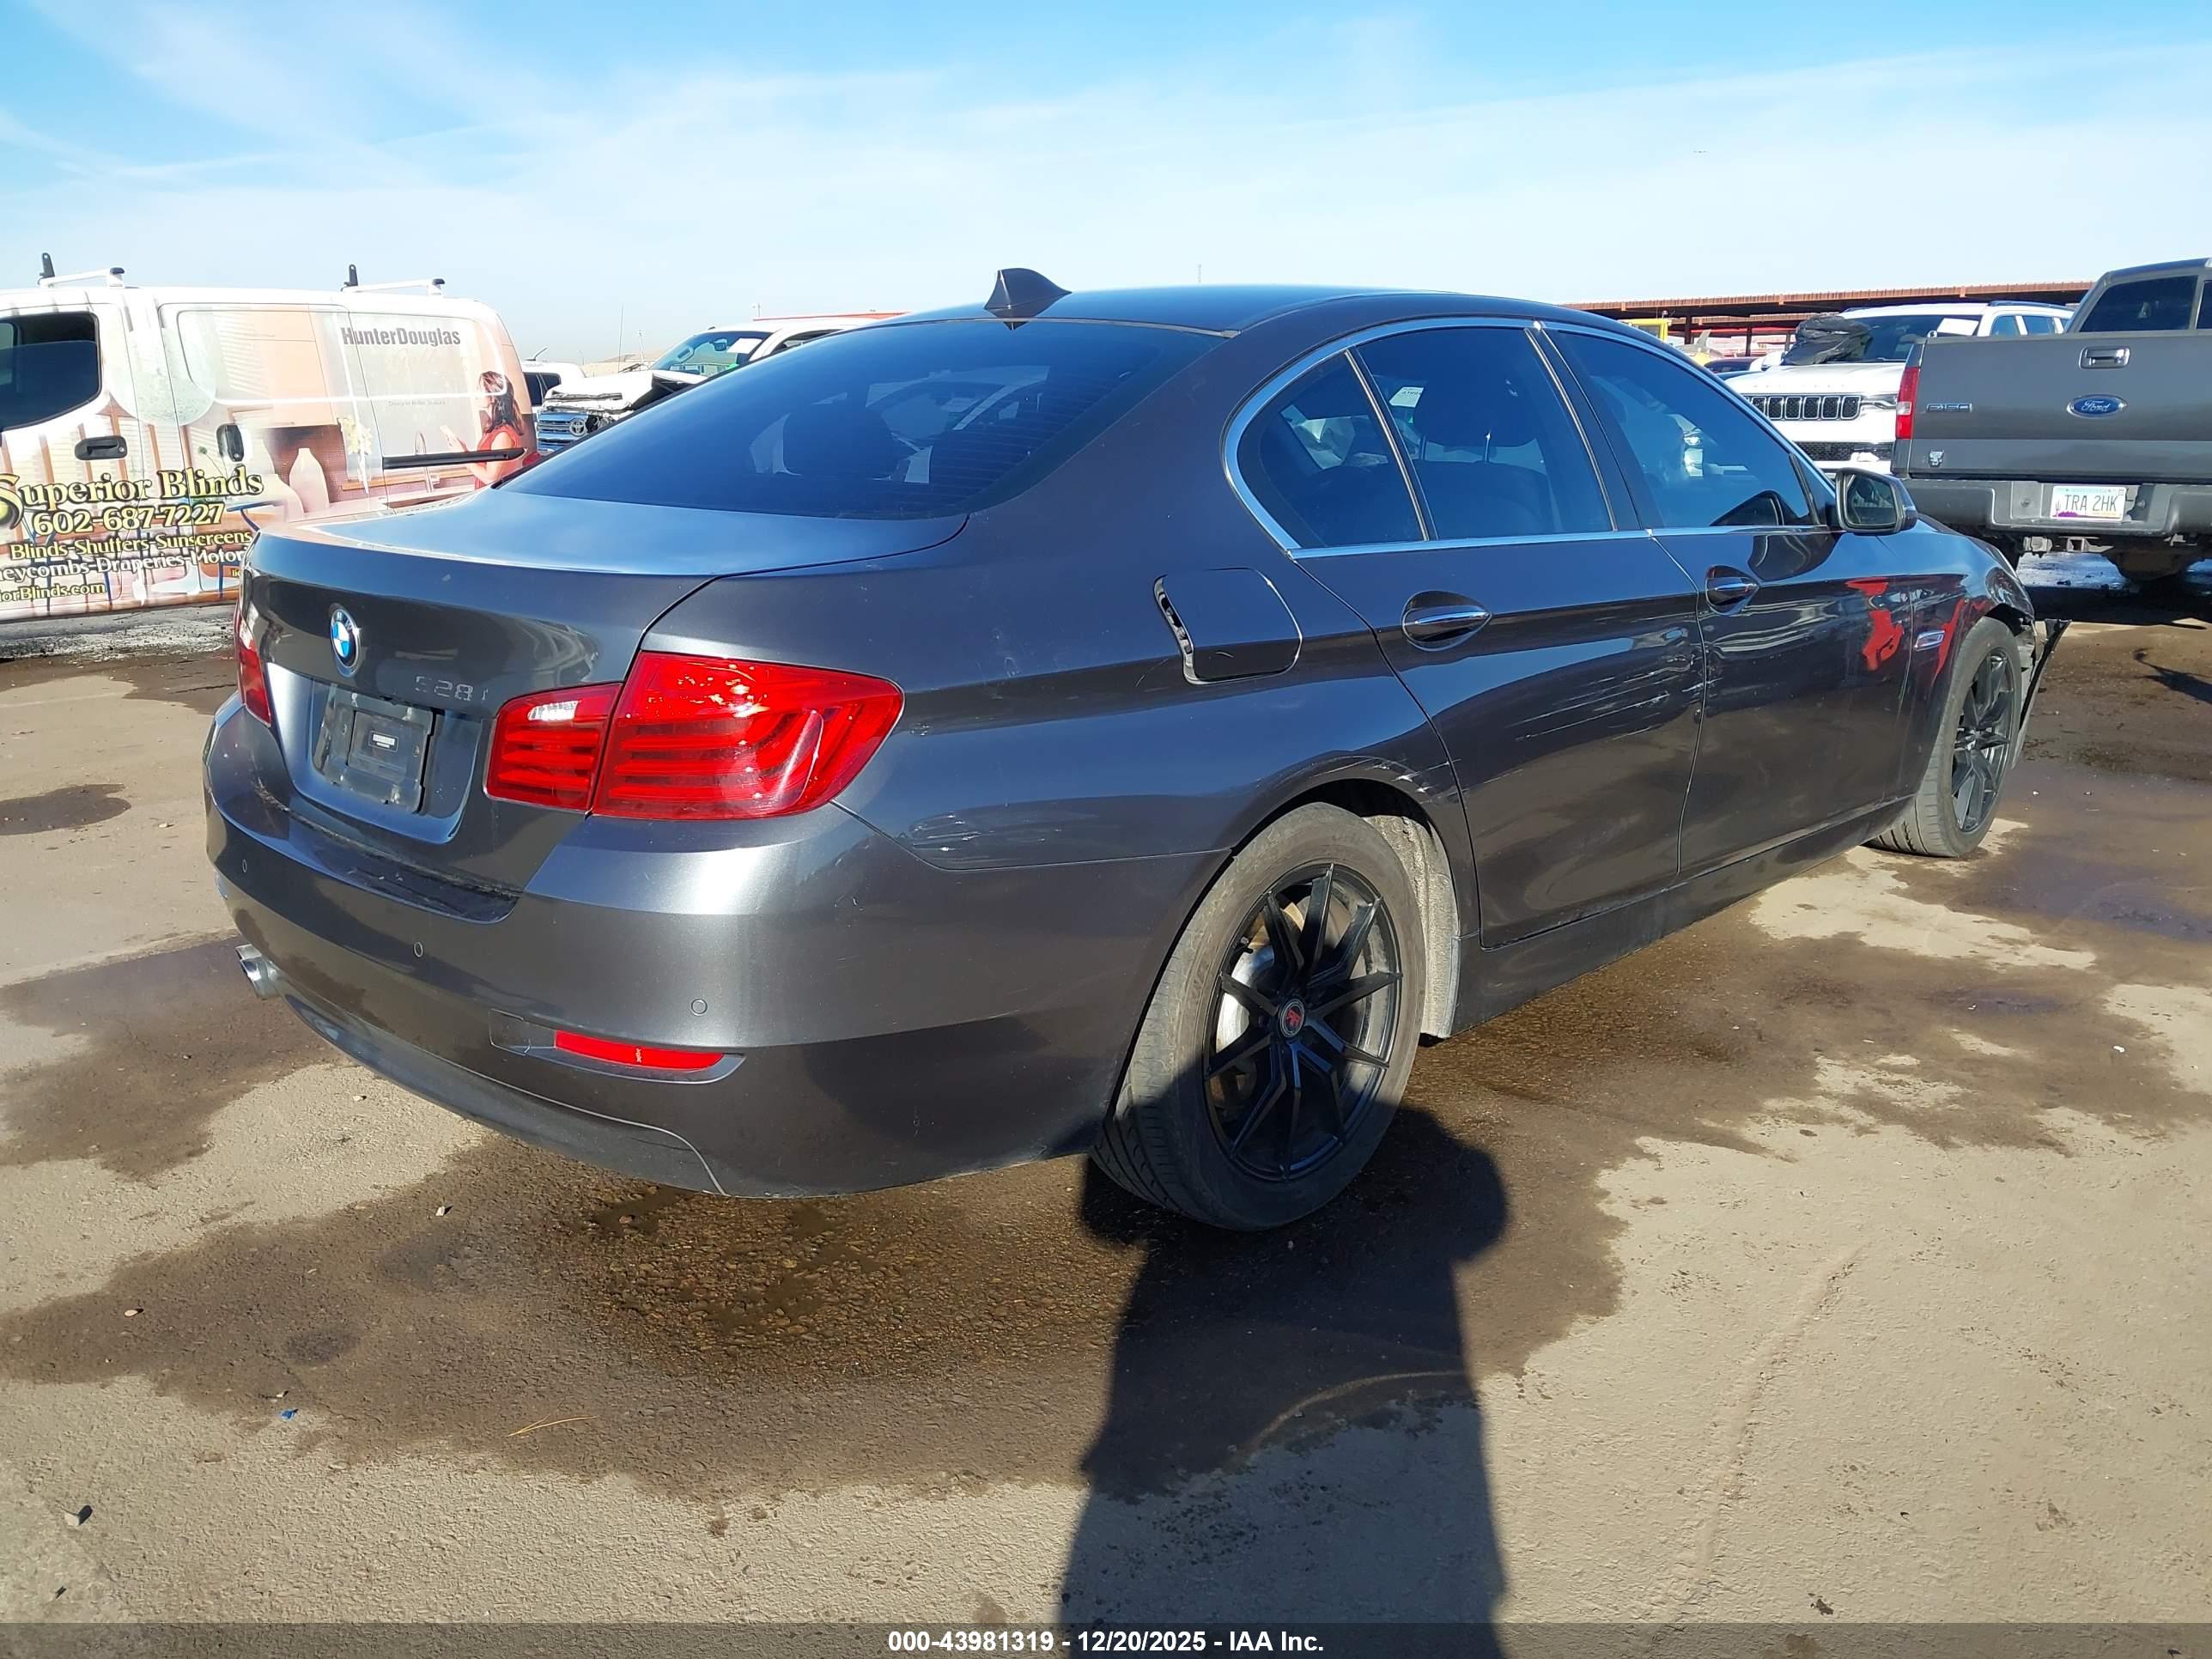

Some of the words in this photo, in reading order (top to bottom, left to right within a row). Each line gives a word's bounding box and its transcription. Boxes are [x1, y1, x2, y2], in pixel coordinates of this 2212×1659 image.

[341, 327, 461, 347] HunterDouglas
[156, 465, 264, 501] Blinds
[2064, 495, 2087, 511] TRA
[2092, 495, 2118, 512] 2HK
[33, 502, 225, 537] 602-687-7227
[0, 583, 106, 602] orBlinds.com
